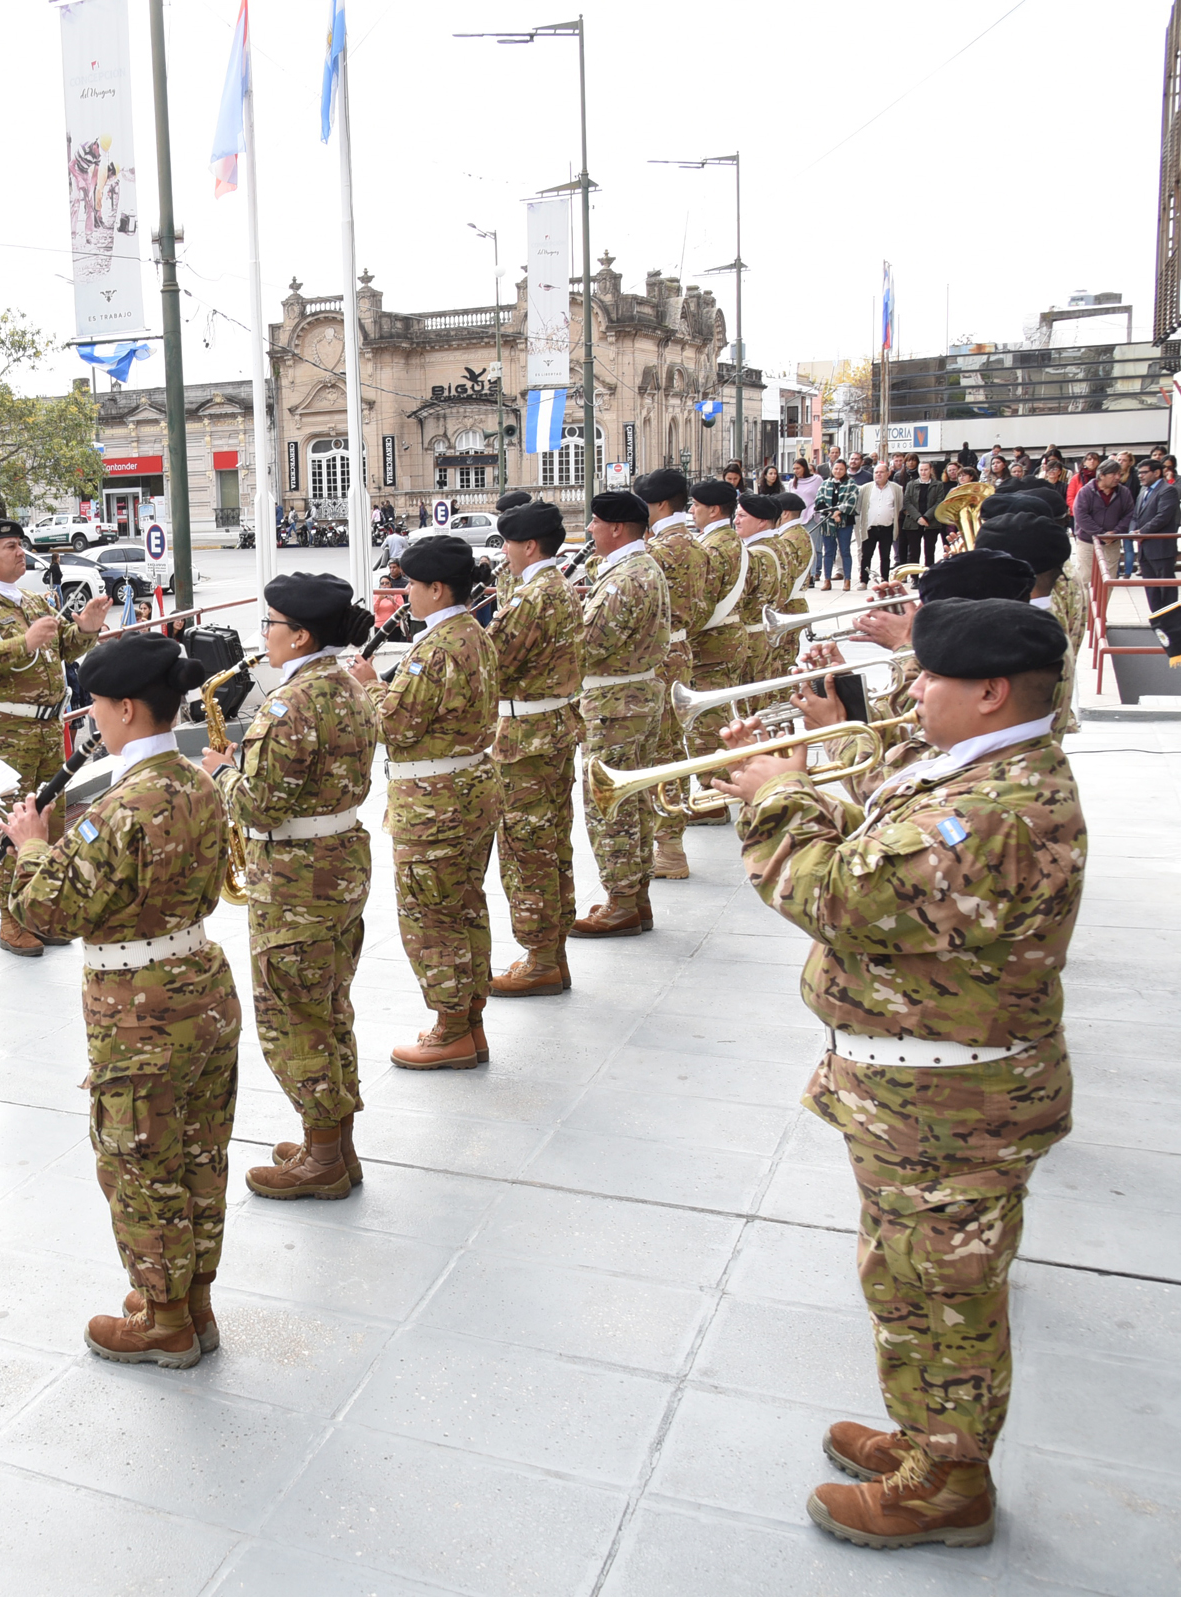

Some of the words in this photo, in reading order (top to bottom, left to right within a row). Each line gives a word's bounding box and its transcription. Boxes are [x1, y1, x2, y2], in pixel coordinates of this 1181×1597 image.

[100, 311, 132, 321] TRABAJO
[875, 427, 912, 439] VTORIA
[875, 442, 912, 450] SUROS
[437, 506, 446, 521] E
[151, 531, 161, 553] E
